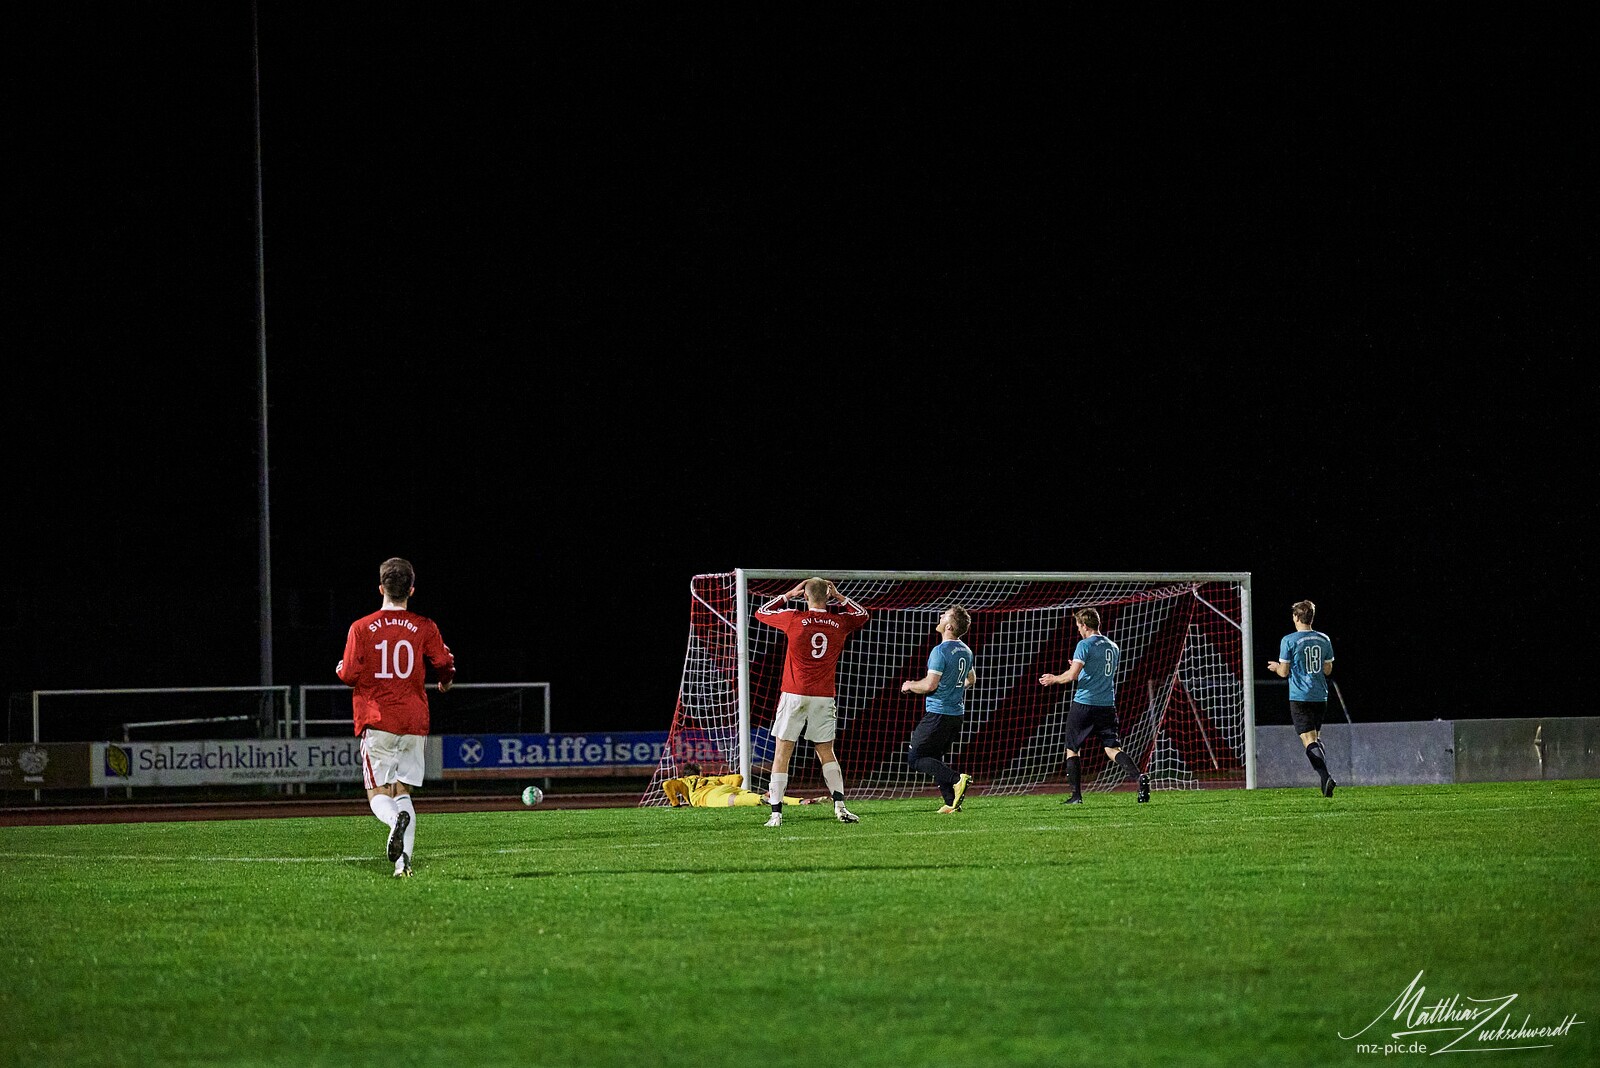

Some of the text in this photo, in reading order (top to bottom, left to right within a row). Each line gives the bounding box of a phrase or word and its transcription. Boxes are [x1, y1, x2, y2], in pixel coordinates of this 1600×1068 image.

[368, 617, 418, 633] SV Laufen
[801, 617, 840, 629] SV Laufen
[374, 639, 415, 679] 10
[811, 632, 828, 659] 9
[955, 657, 967, 688] 2
[1304, 645, 1322, 674] 13
[139, 743, 363, 770] Salzachklinik Frido
